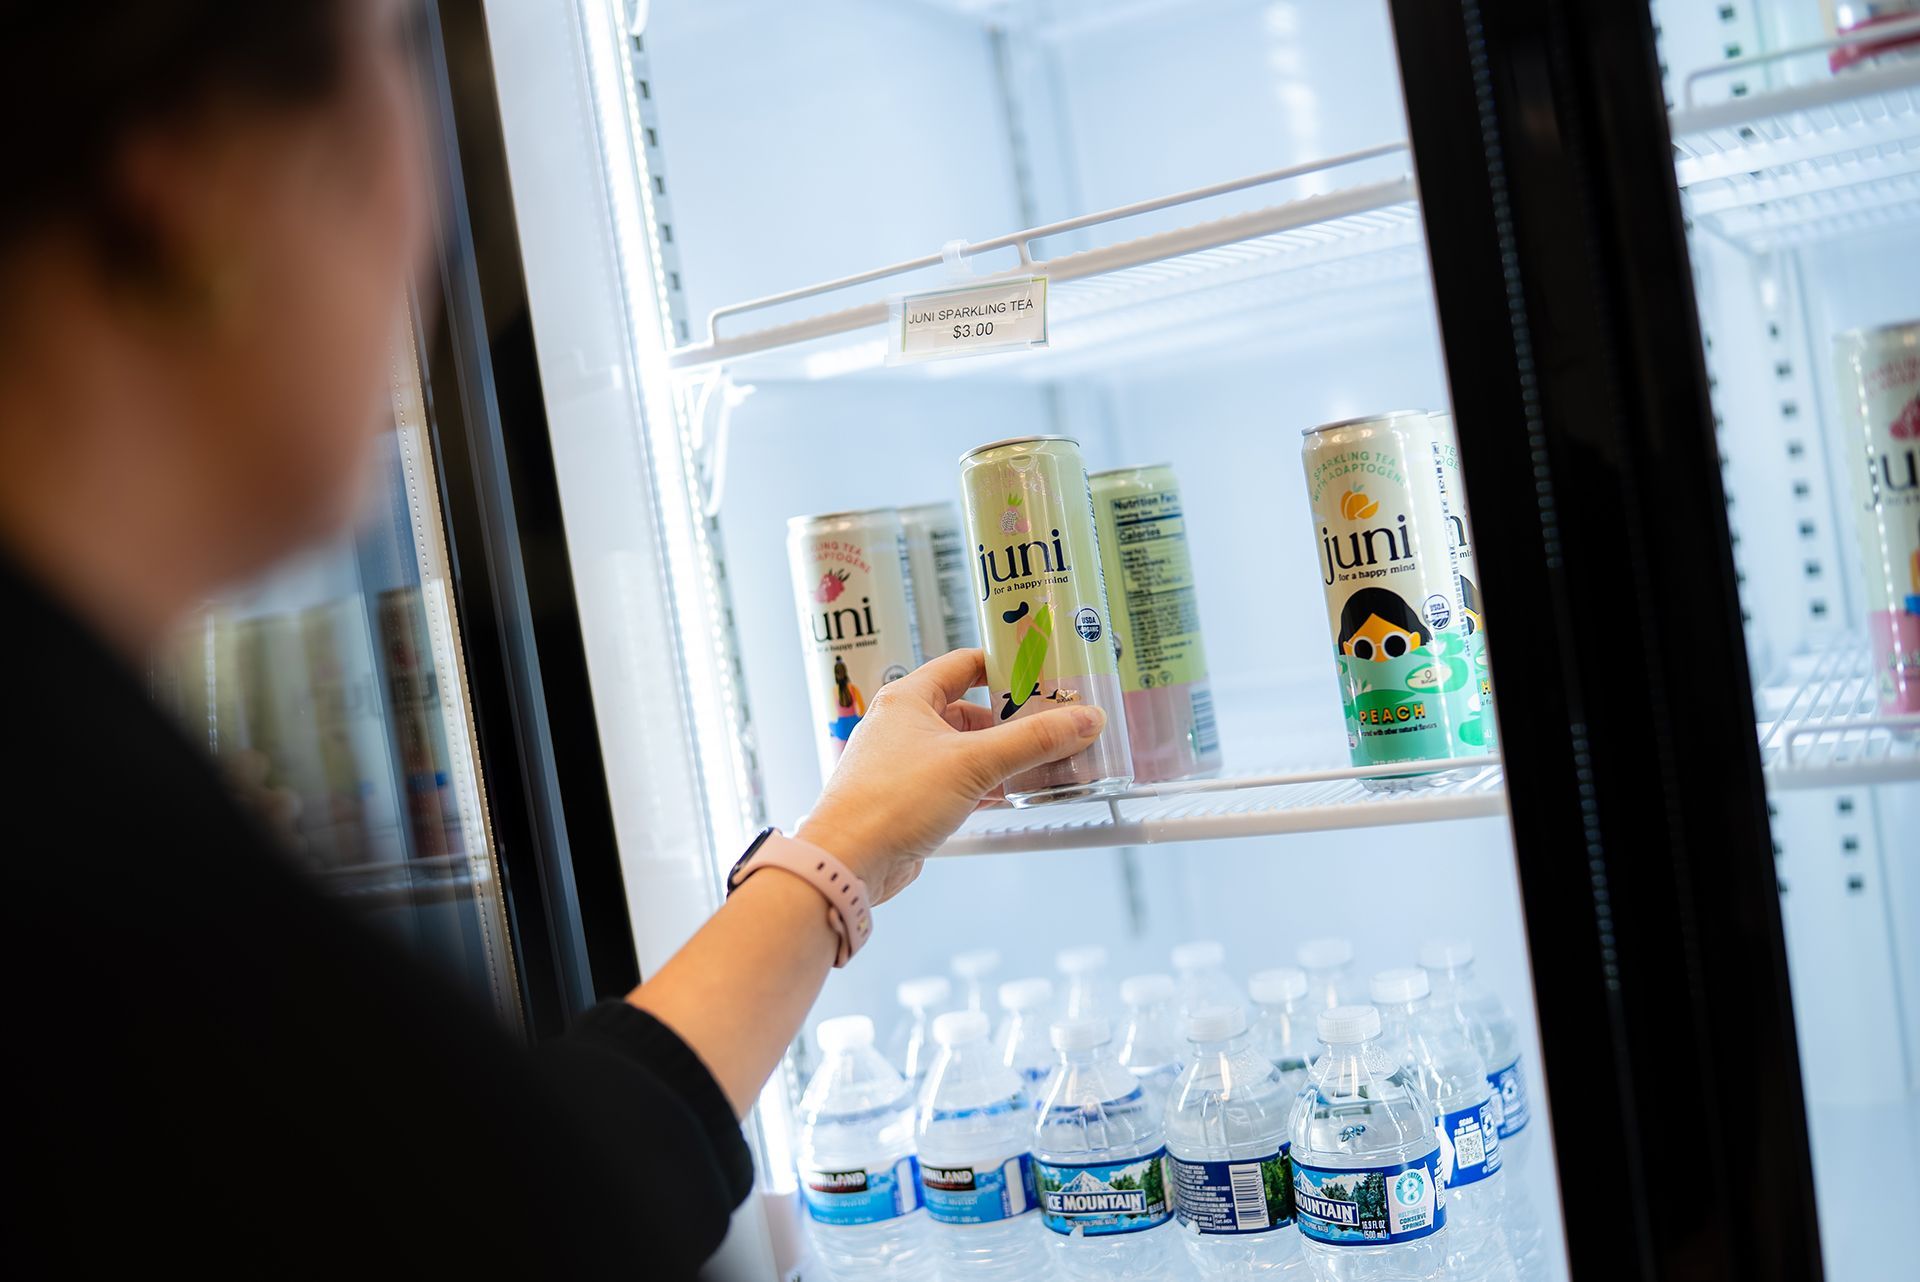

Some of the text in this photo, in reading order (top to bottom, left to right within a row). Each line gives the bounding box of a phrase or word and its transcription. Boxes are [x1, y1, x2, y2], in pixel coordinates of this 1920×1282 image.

[908, 299, 1034, 325] JUNI SPARKLING TEA
[953, 321, 994, 340] $3.00
[1313, 451, 1396, 481] SPARKLING TEA
[1313, 463, 1408, 502] WITH ADAPTOGENS
[1113, 497, 1158, 510] Nutrition
[1120, 528, 1160, 541] Calories
[842, 543, 863, 555] TEA
[1322, 513, 1413, 586] juni
[815, 551, 872, 574] APTOGENS
[978, 528, 1067, 602] juni
[1338, 573, 1350, 582] for
[1358, 568, 1388, 579] happy
[1390, 563, 1416, 574] mind
[993, 575, 1069, 596] for a happy mind
[811, 595, 876, 643] uni
[1081, 616, 1097, 625] USDA
[1358, 703, 1427, 726] PEACH
[1398, 723, 1419, 735] natural
[1063, 1193, 1142, 1212] MOUNTAIN
[1294, 1188, 1353, 1222] MOUNTAIN
[1361, 1219, 1386, 1230] 16.9 FL OZ
[1399, 1212, 1427, 1225] CONSERVE
[1401, 1219, 1426, 1230] SPRINGS
[1363, 1229, 1387, 1240] (500 mL)
